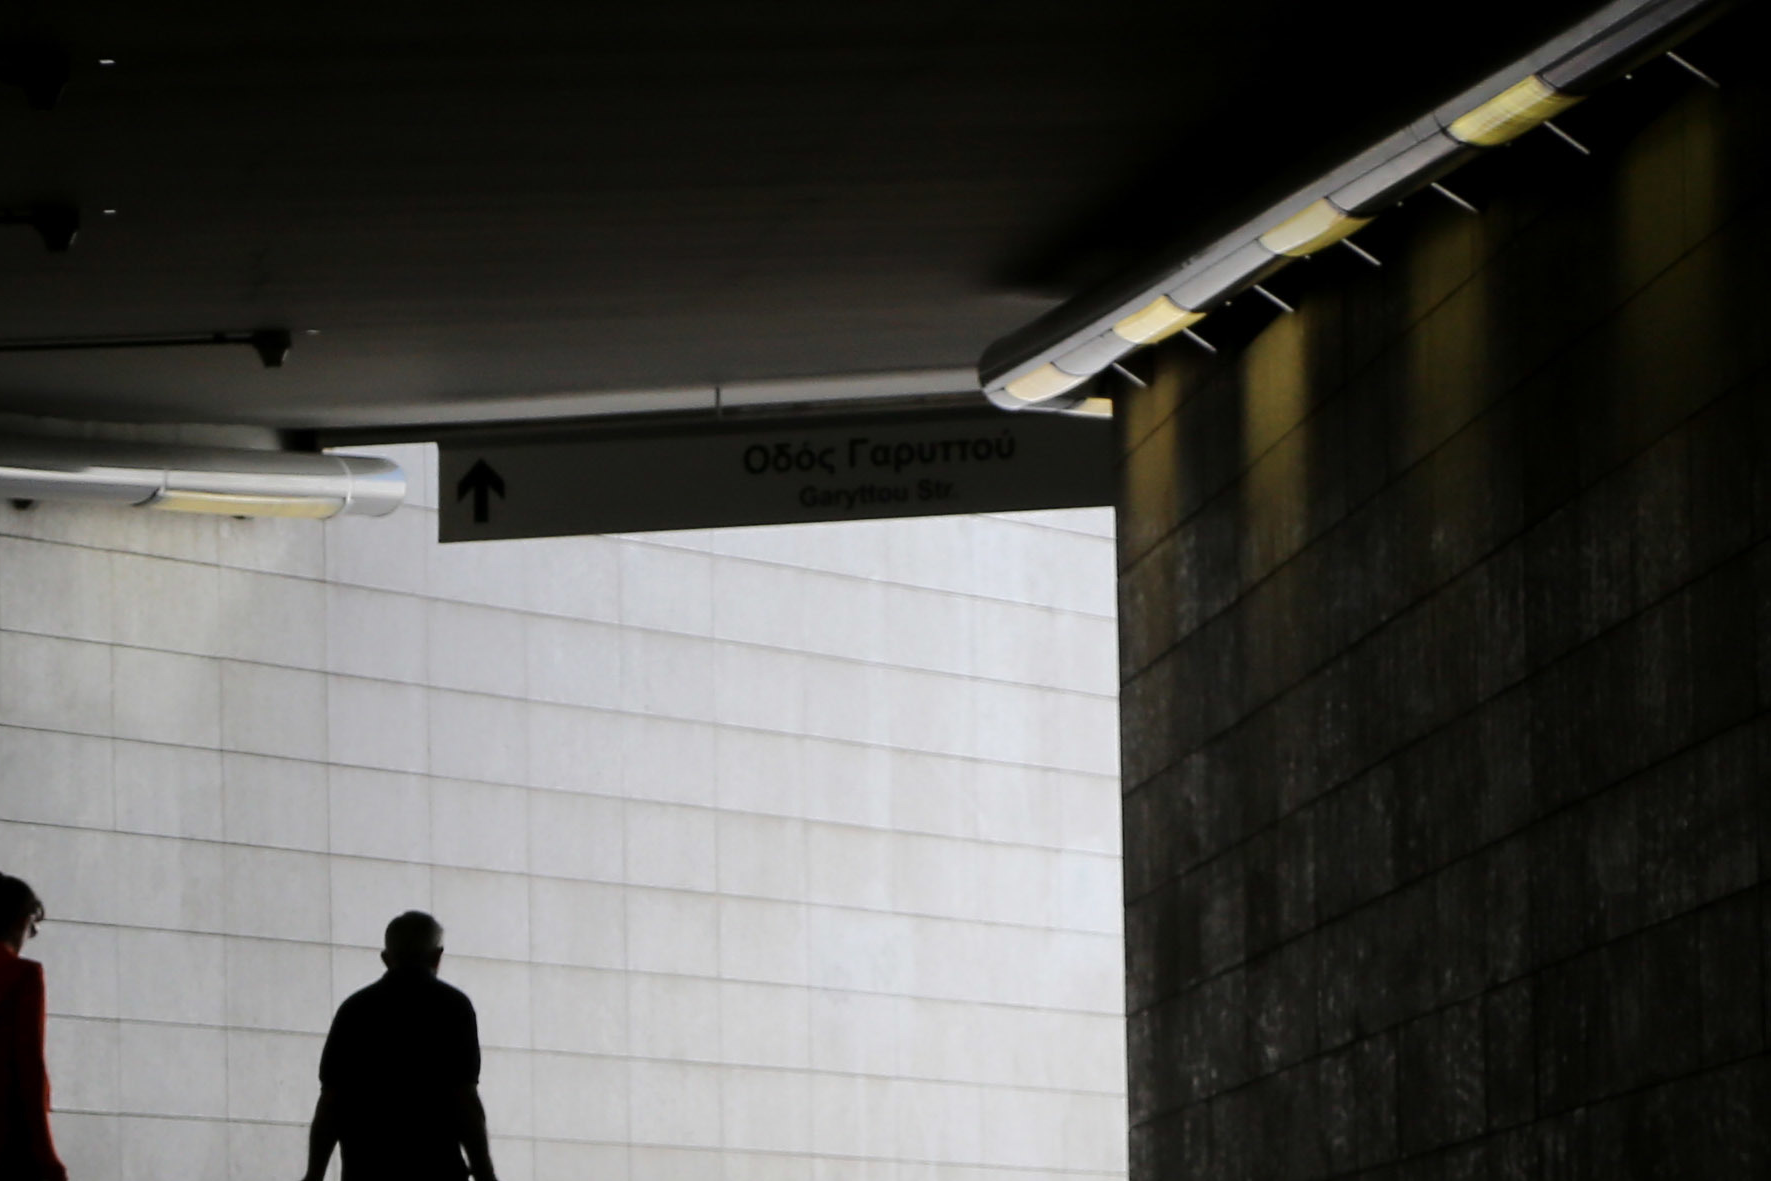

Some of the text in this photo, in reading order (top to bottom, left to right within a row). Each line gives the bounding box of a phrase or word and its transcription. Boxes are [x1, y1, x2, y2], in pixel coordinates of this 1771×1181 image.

[743, 429, 1016, 474] Οδός Γαρυττού
[799, 477, 960, 510] Garyttou Str.
